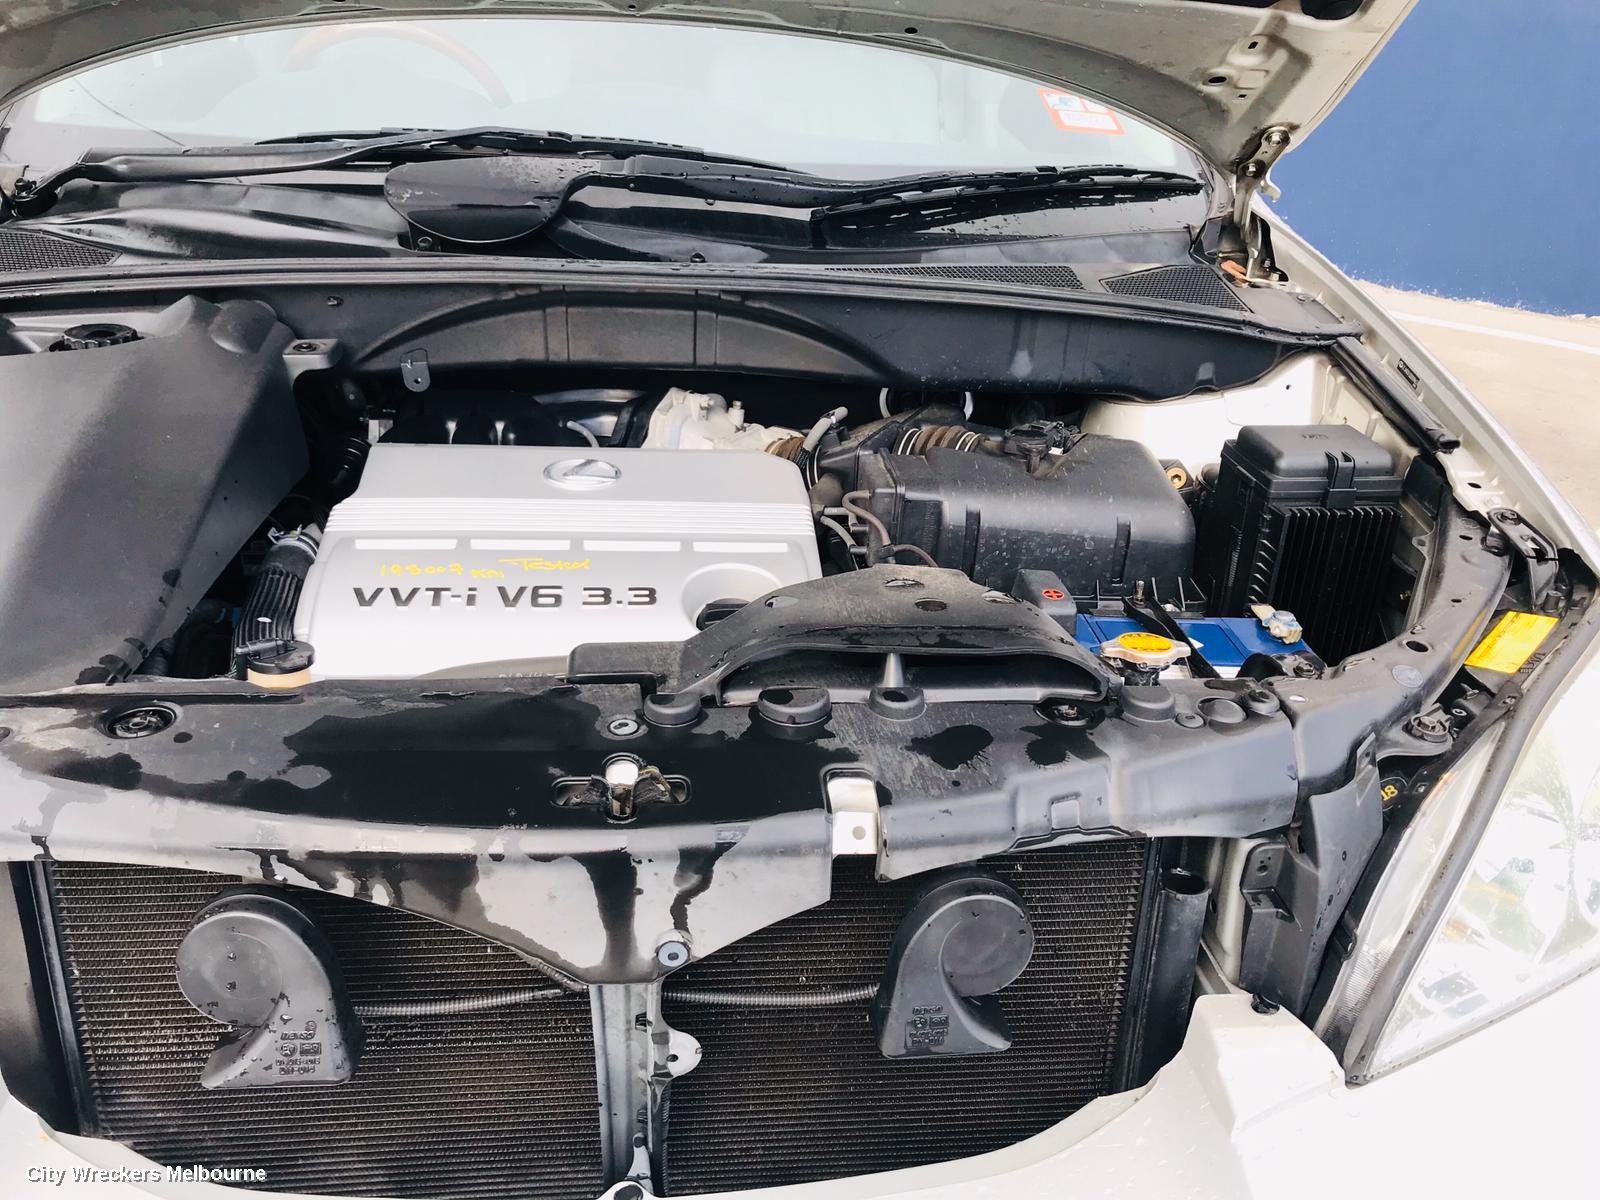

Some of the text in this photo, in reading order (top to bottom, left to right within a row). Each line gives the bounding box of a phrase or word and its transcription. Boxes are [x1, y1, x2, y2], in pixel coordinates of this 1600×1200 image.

[353, 585, 657, 608] VVT-i V6 3.3
